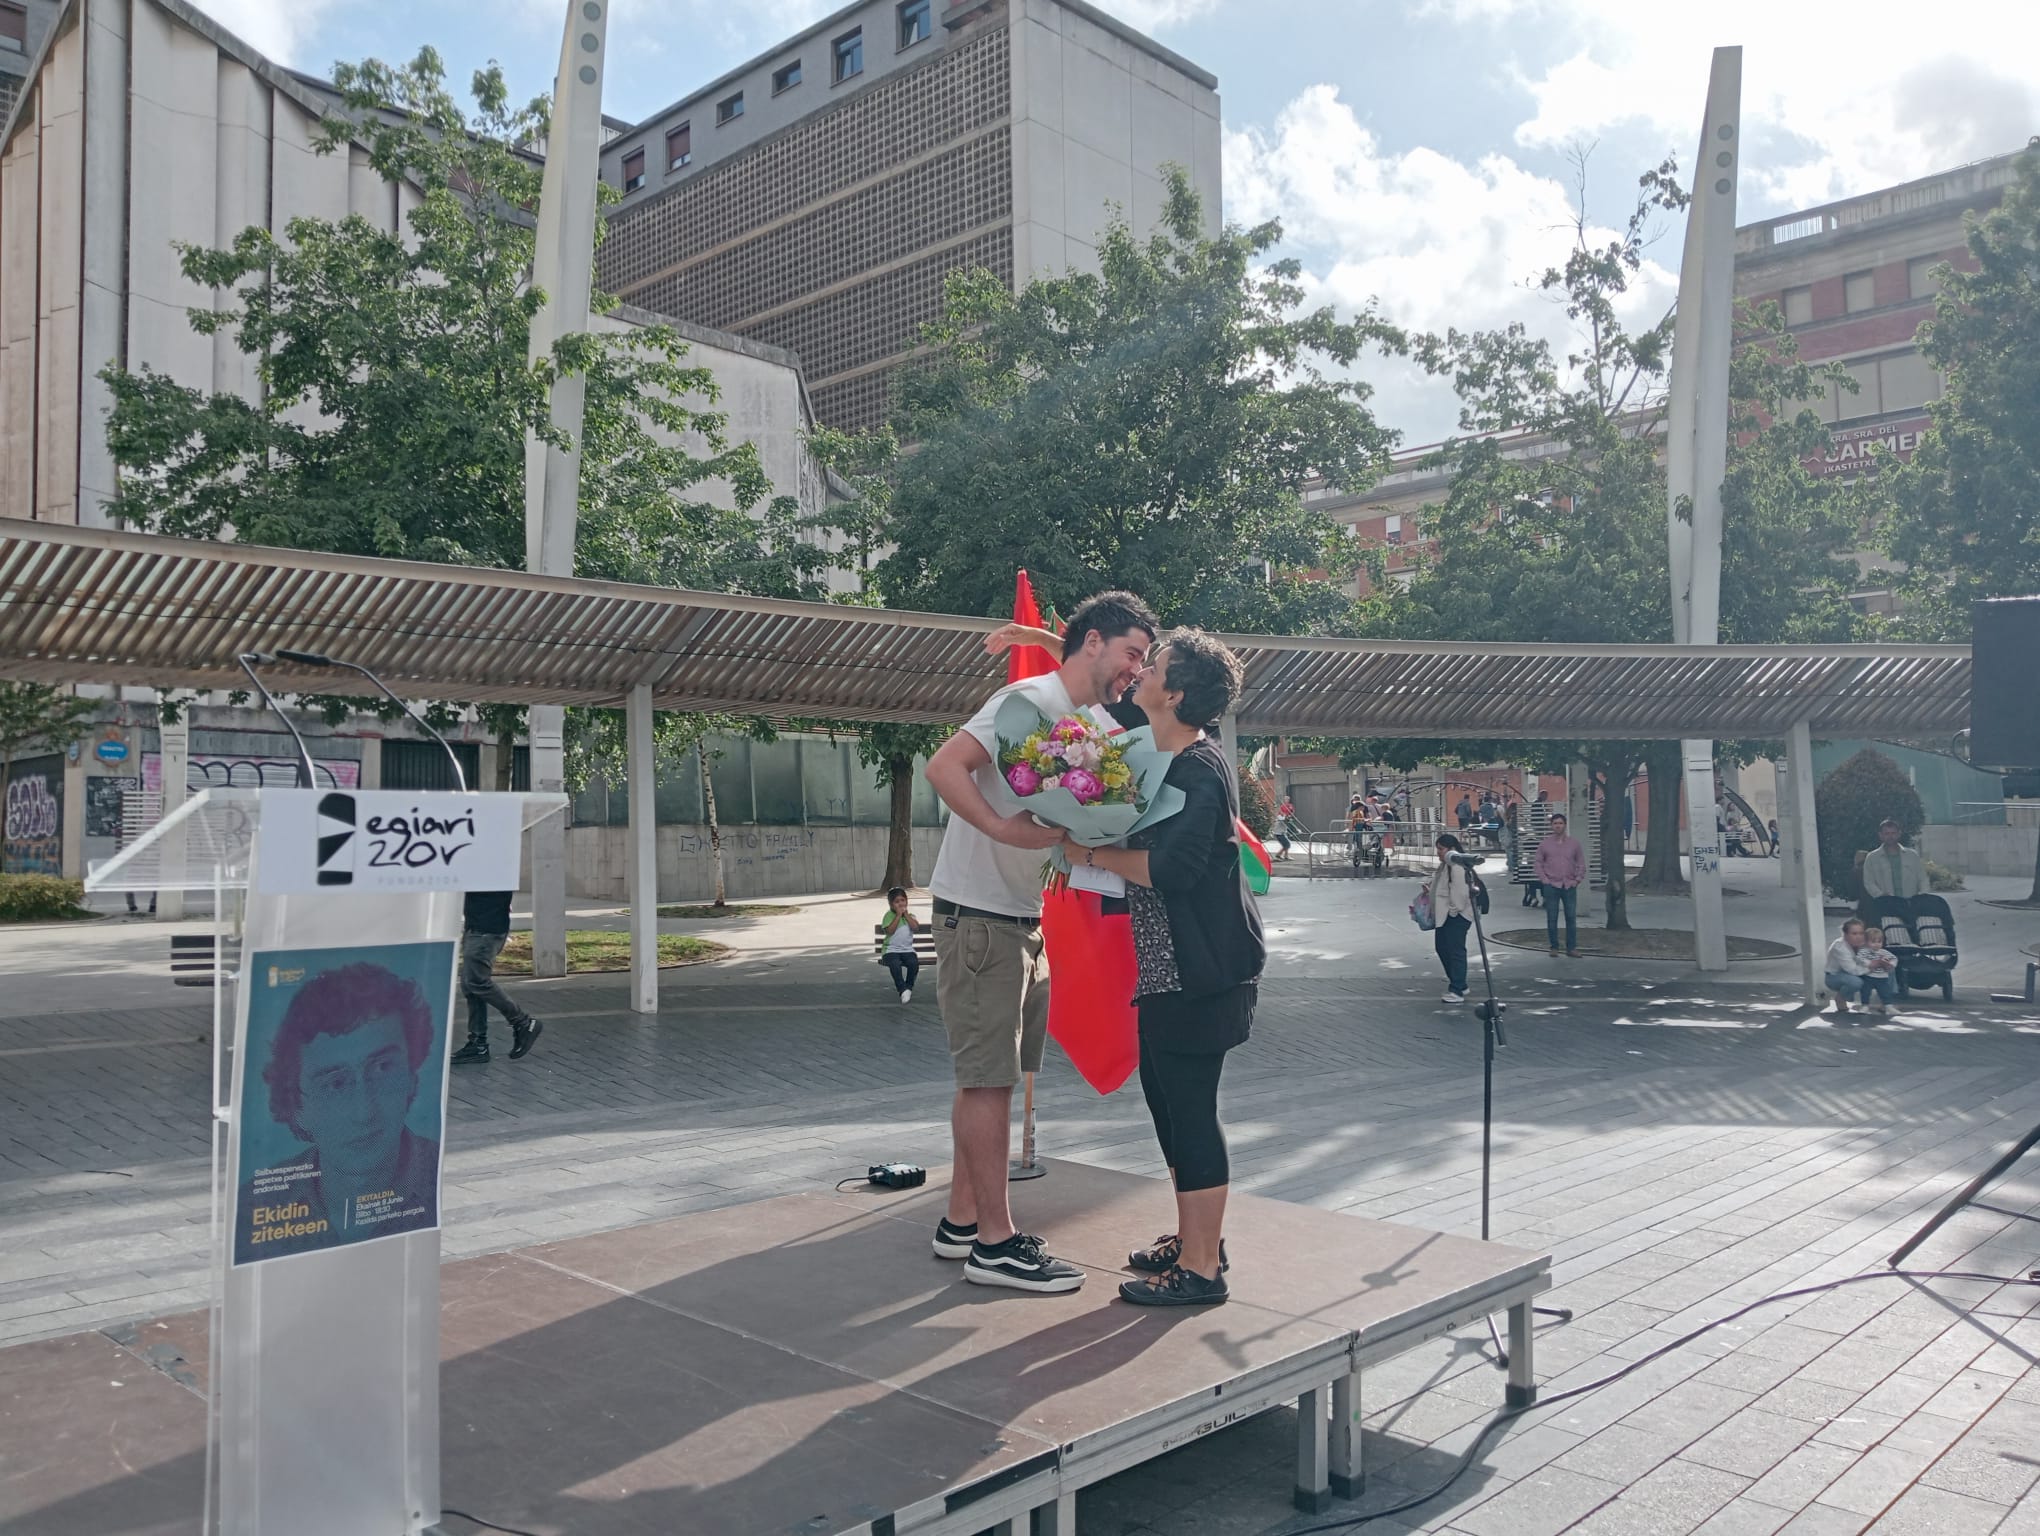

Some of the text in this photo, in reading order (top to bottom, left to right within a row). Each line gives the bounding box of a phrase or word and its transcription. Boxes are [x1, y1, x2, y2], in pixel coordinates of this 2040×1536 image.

[1879, 425, 1898, 435] DEL
[252, 1202, 310, 1226] Ekidin
[251, 1219, 329, 1244] zitekeen
